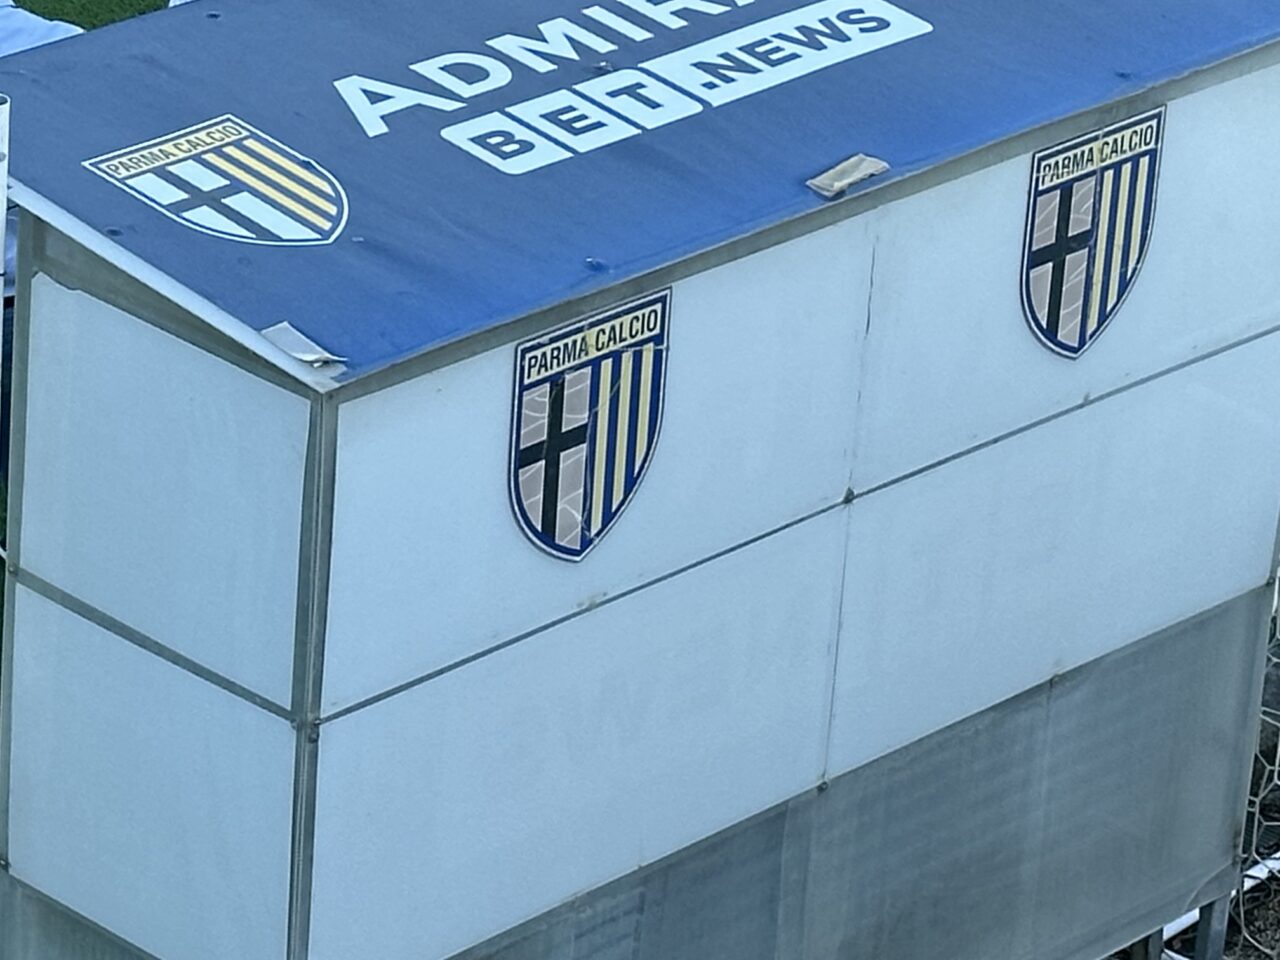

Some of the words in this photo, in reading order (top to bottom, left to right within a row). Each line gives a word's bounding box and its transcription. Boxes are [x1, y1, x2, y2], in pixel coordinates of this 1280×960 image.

[105, 148, 177, 176] PARMA
[173, 125, 243, 155] CALCIO
[1041, 147, 1094, 186] PARMA
[1100, 124, 1154, 163] CALCIO
[526, 335, 589, 380] PARMA
[595, 308, 658, 352] CALCIO
